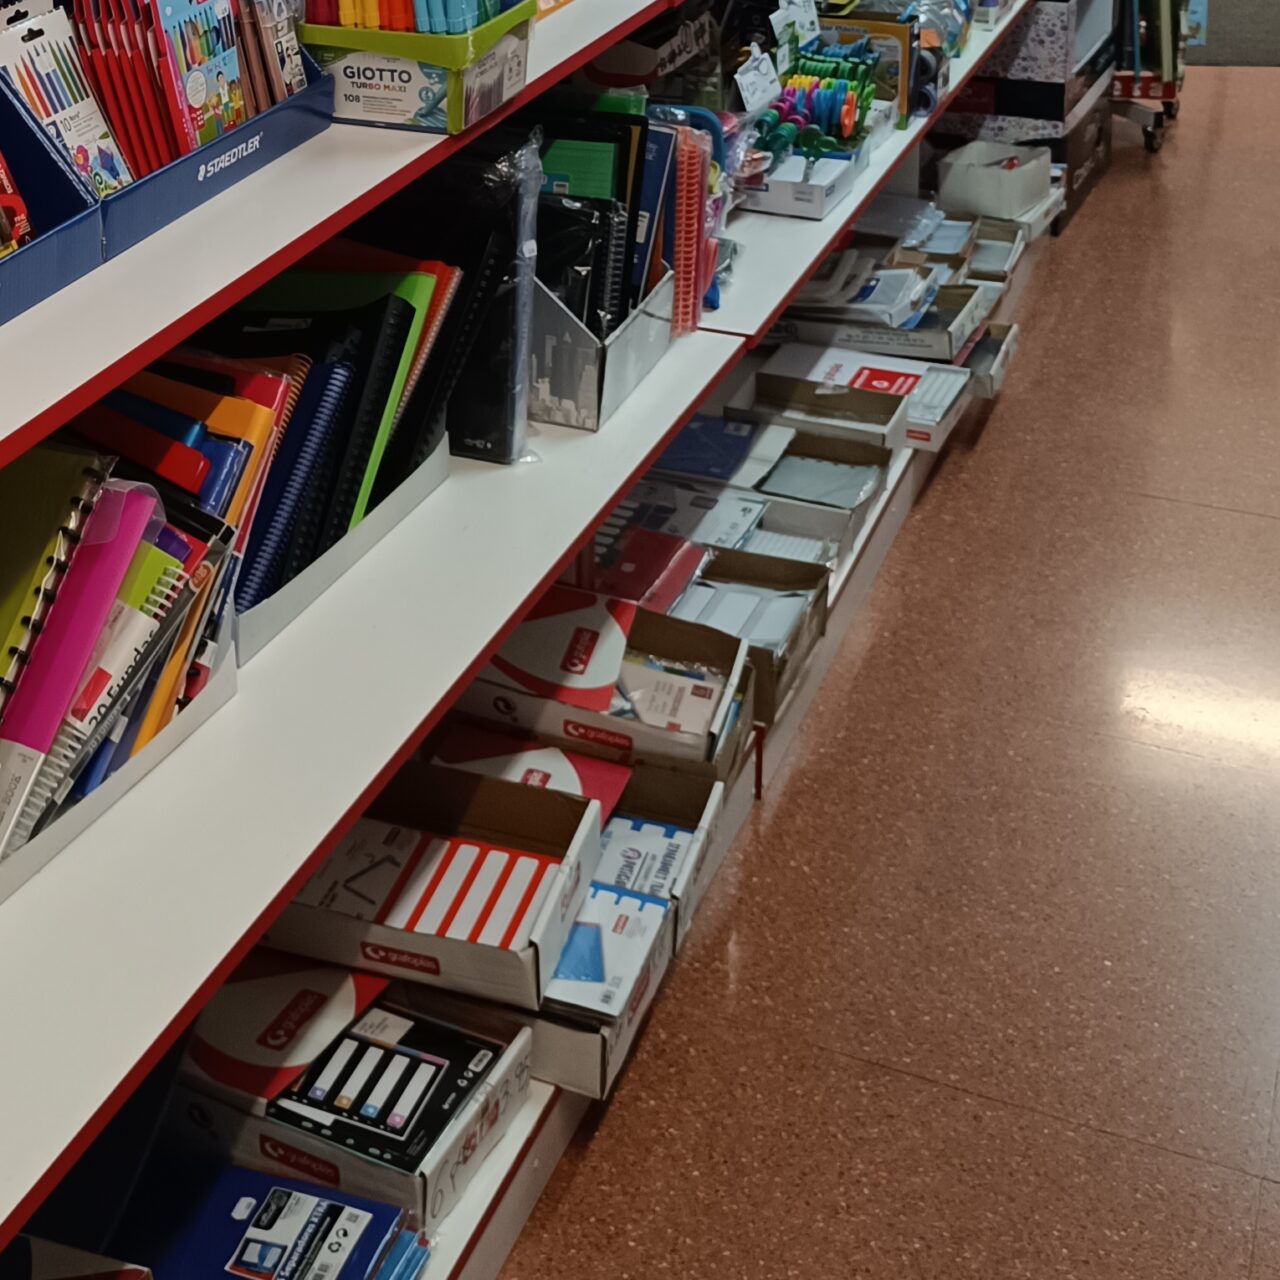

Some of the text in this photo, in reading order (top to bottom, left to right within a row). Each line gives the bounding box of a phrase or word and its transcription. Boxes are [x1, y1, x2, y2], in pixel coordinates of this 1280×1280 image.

[343, 65, 413, 84] GIOTTO
[351, 81, 407, 93] TURBO MAXI
[343, 93, 361, 103] 108
[205, 134, 261, 179] STAEDTLER
